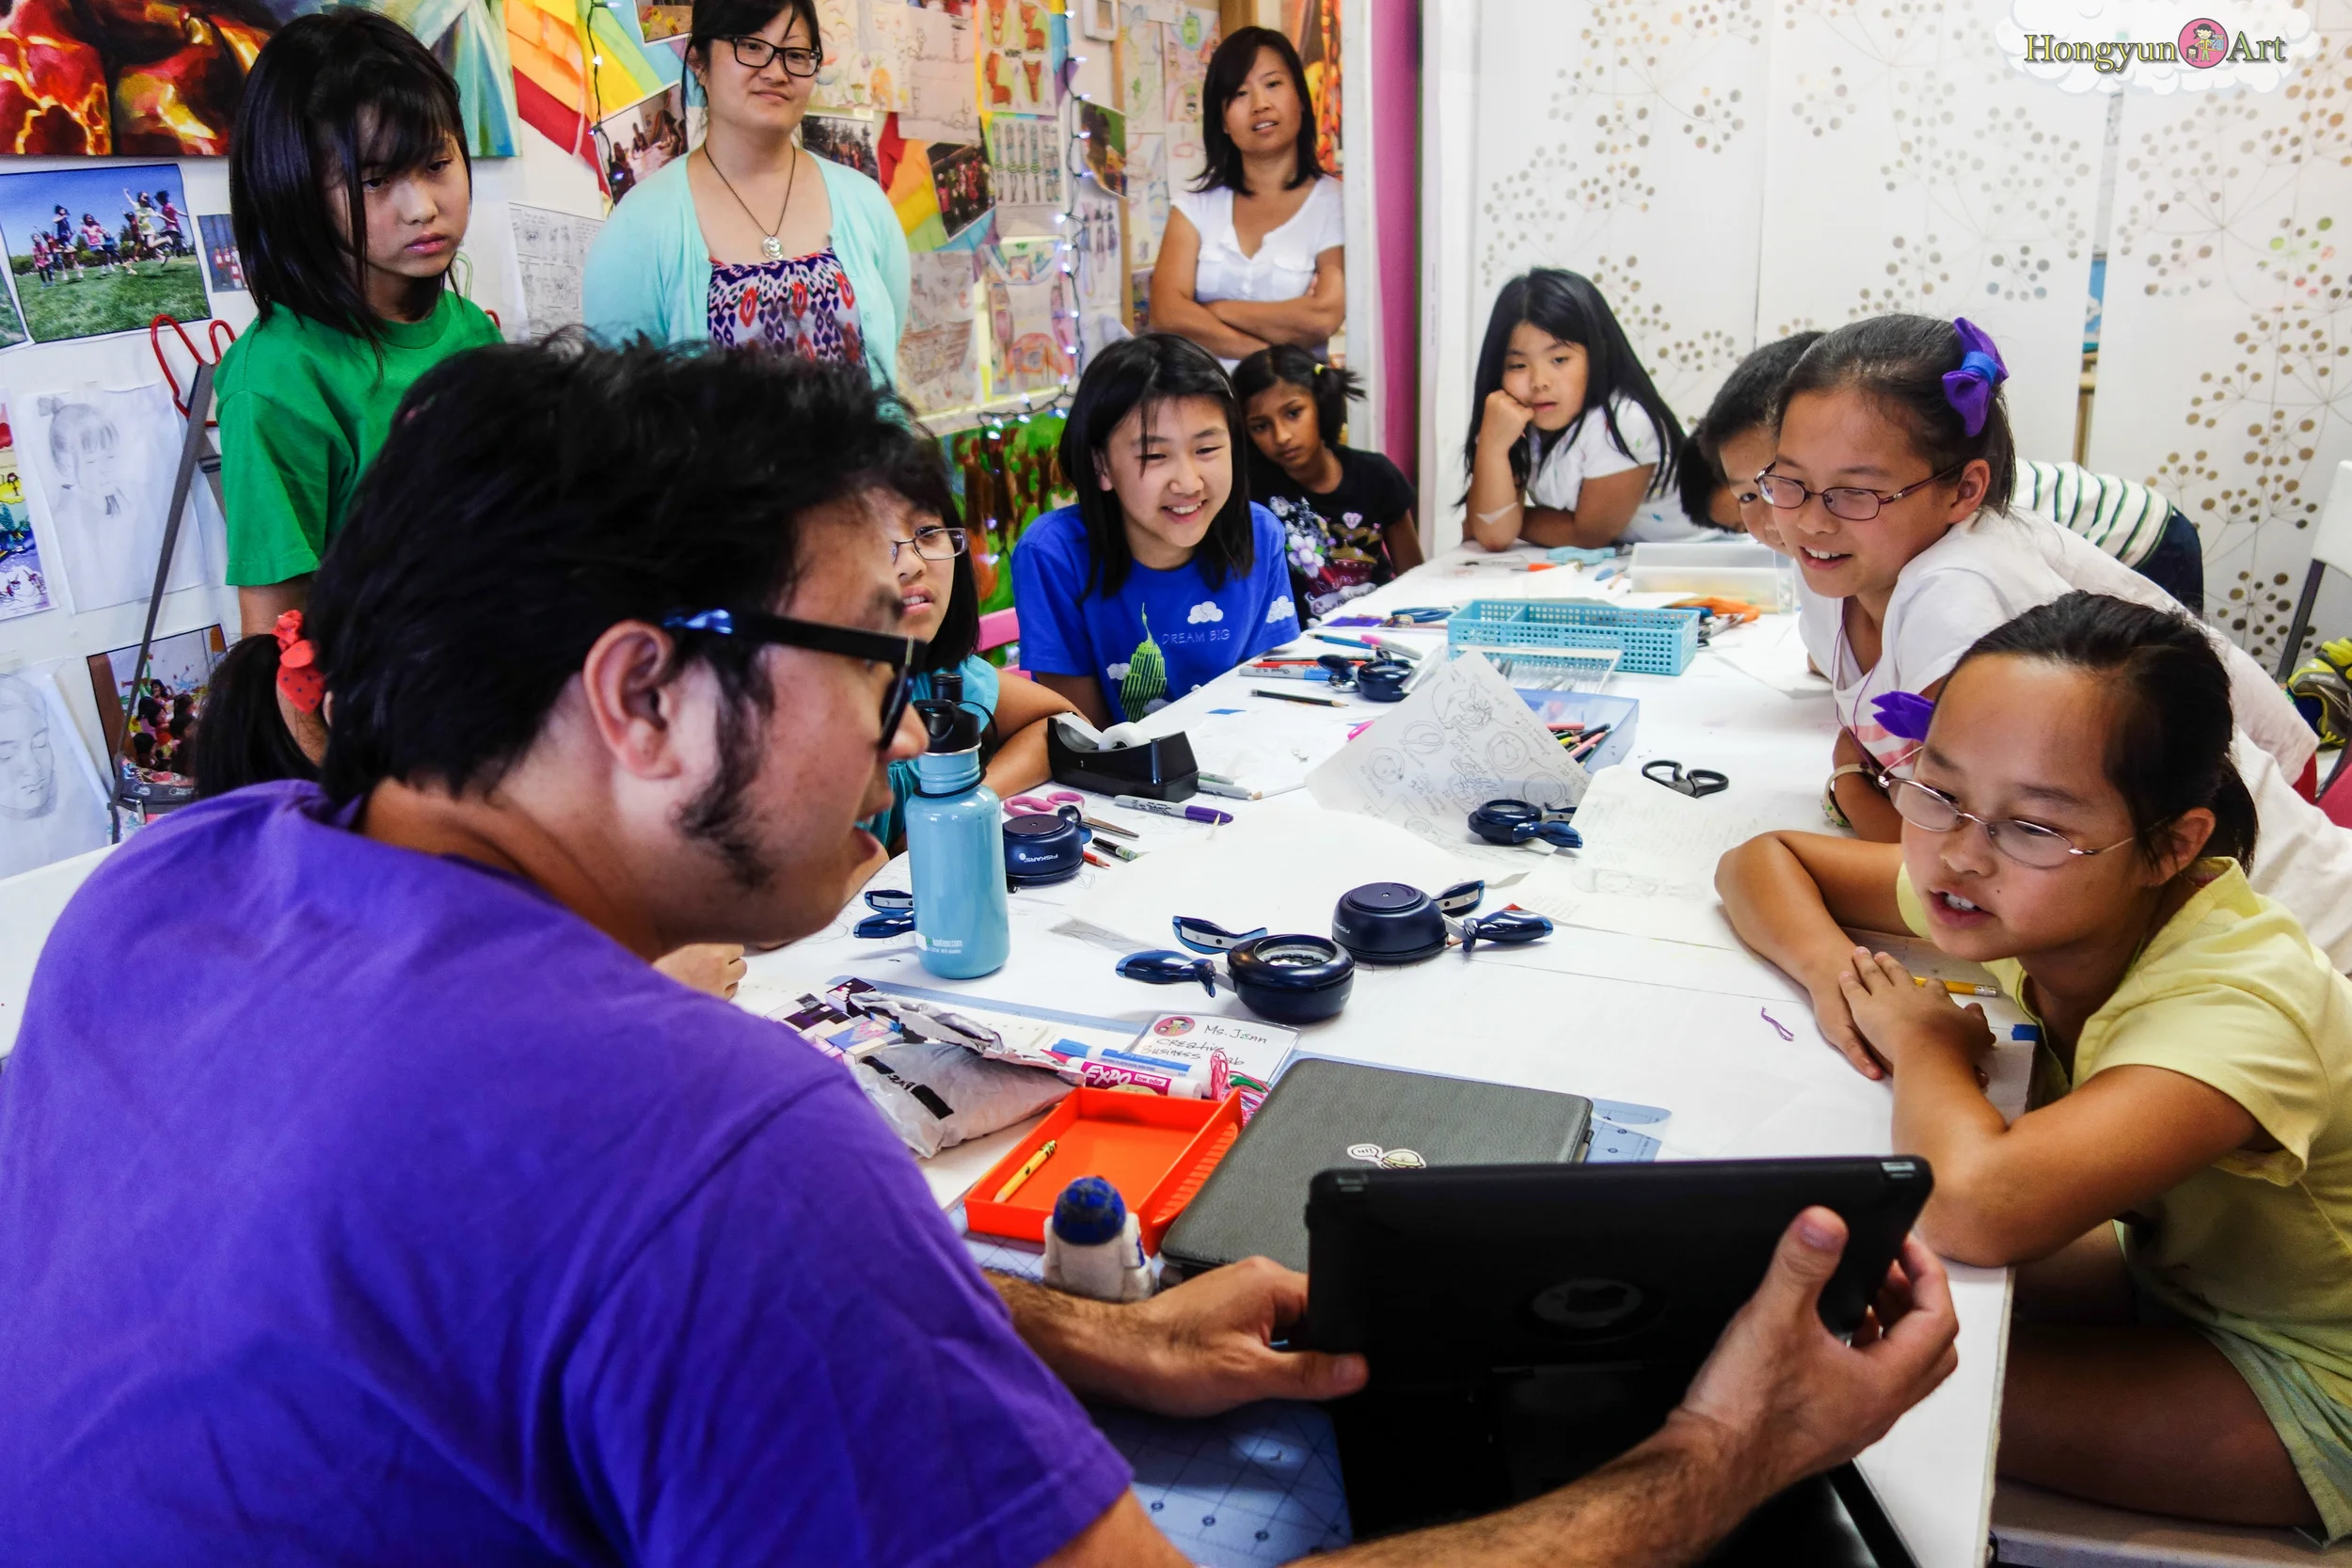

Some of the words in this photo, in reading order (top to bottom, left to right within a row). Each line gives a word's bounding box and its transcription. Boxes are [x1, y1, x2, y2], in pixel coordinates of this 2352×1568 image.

[1162, 631, 1205, 645] DREAM
[1209, 628, 1231, 641] BIG
[1204, 1024, 1227, 1036] Ms.
[1083, 1065, 1133, 1085] EXPO
[1136, 1074, 1148, 1083] low
[1149, 1078, 1164, 1086] odor
